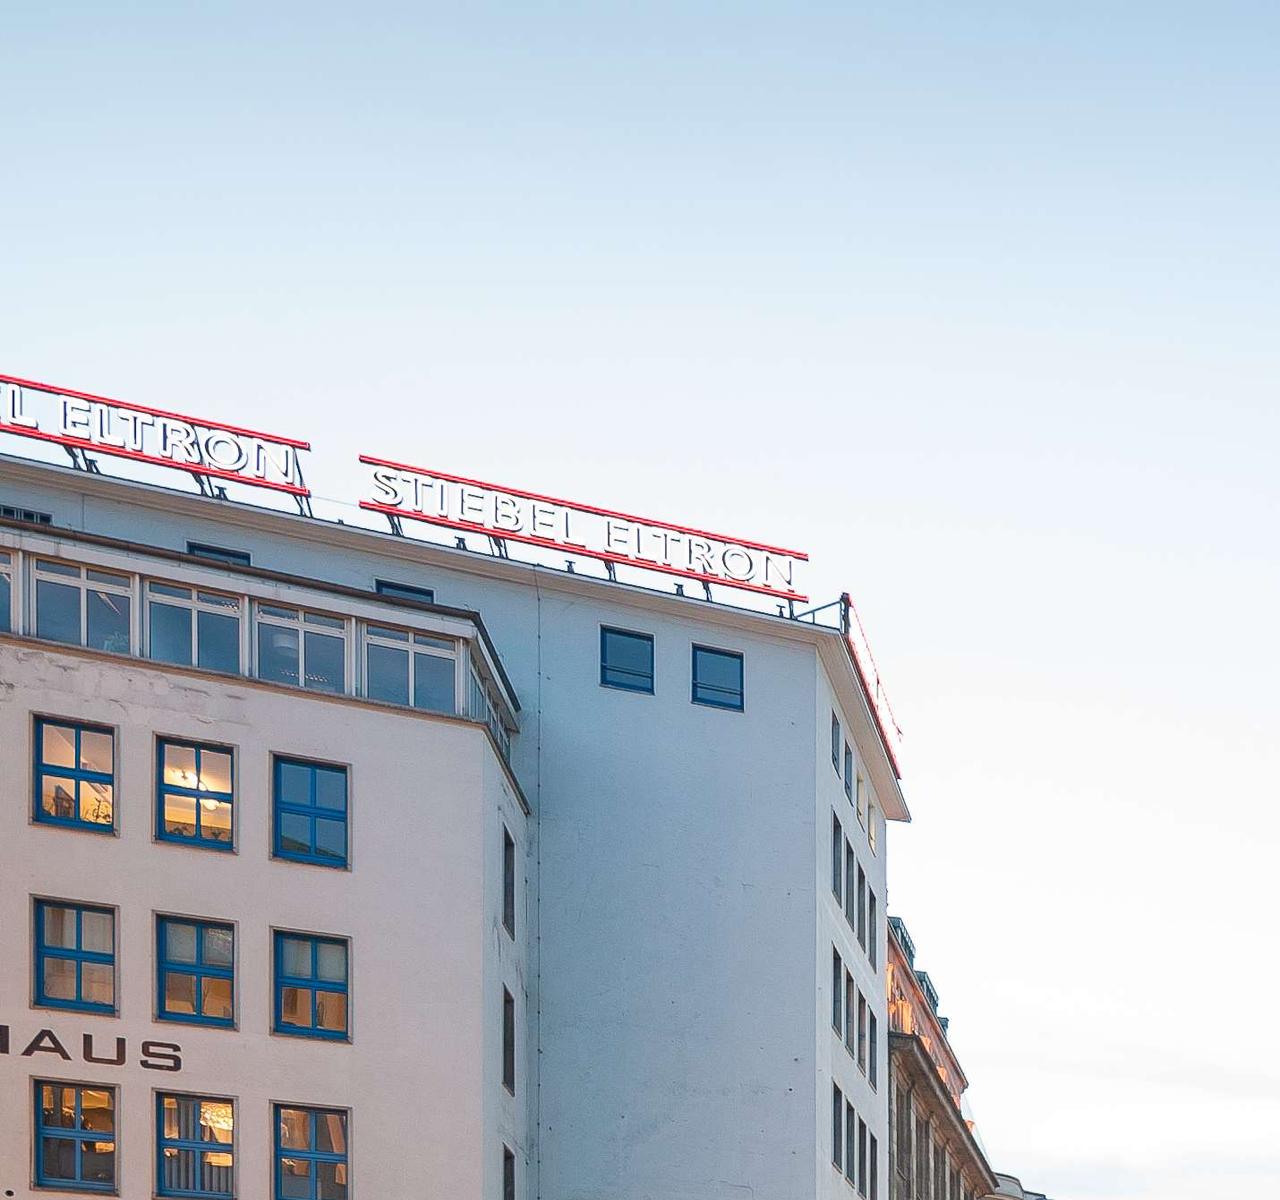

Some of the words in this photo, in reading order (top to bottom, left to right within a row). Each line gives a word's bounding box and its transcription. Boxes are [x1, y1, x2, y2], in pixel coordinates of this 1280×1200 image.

[58, 393, 296, 487] ELTRON
[371, 469, 587, 549] STIEBEL
[604, 516, 797, 592] ELTRON
